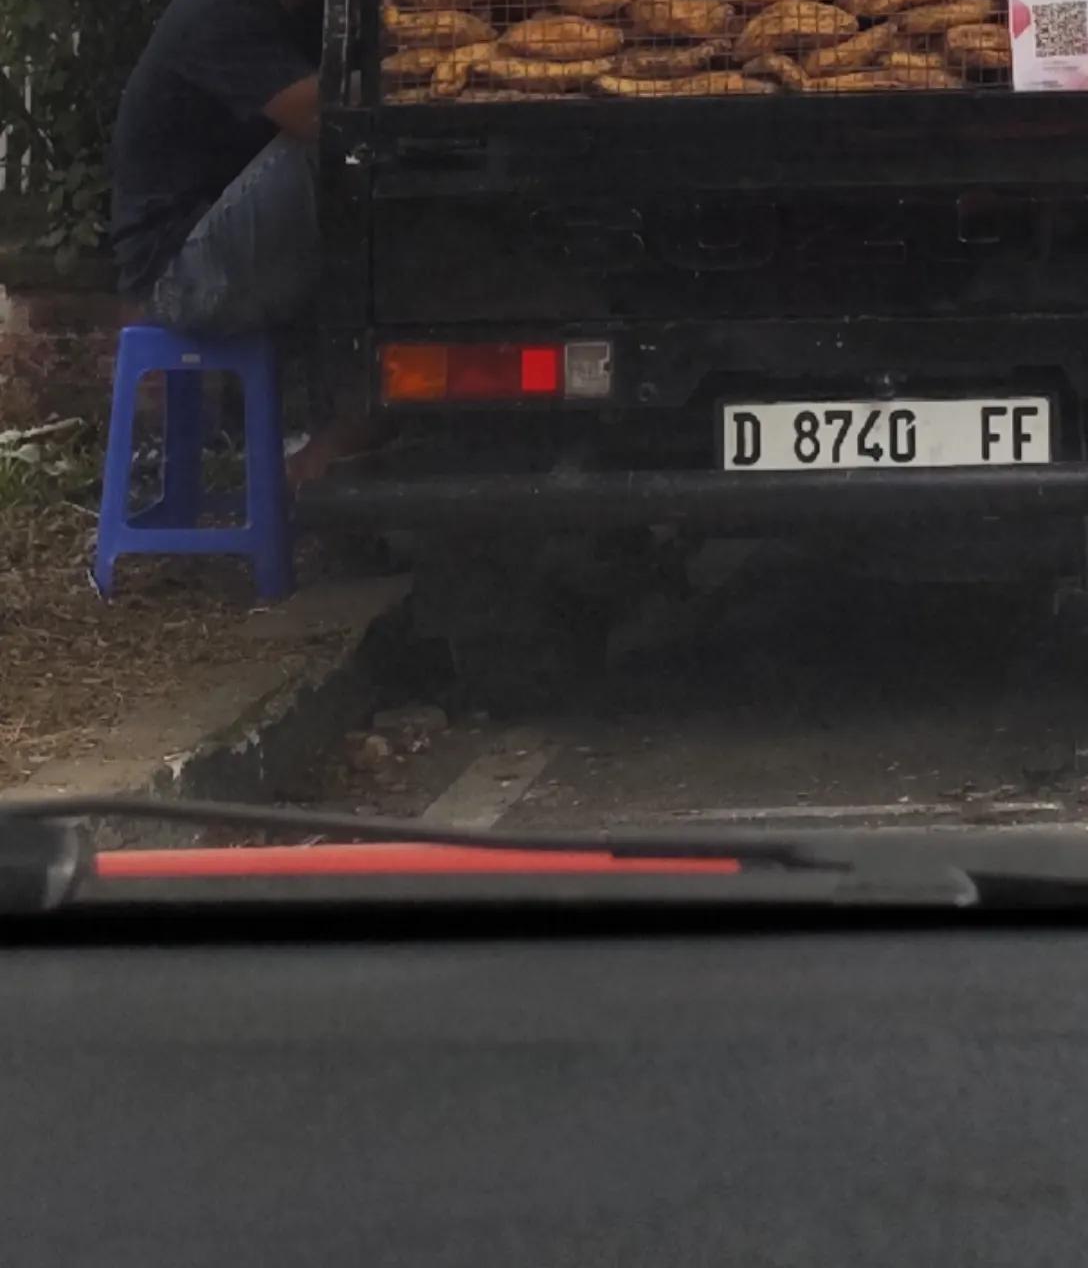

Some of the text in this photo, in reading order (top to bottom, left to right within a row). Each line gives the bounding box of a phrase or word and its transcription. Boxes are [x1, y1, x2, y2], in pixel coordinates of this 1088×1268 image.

[732, 406, 1039, 466] D 8740 FF
